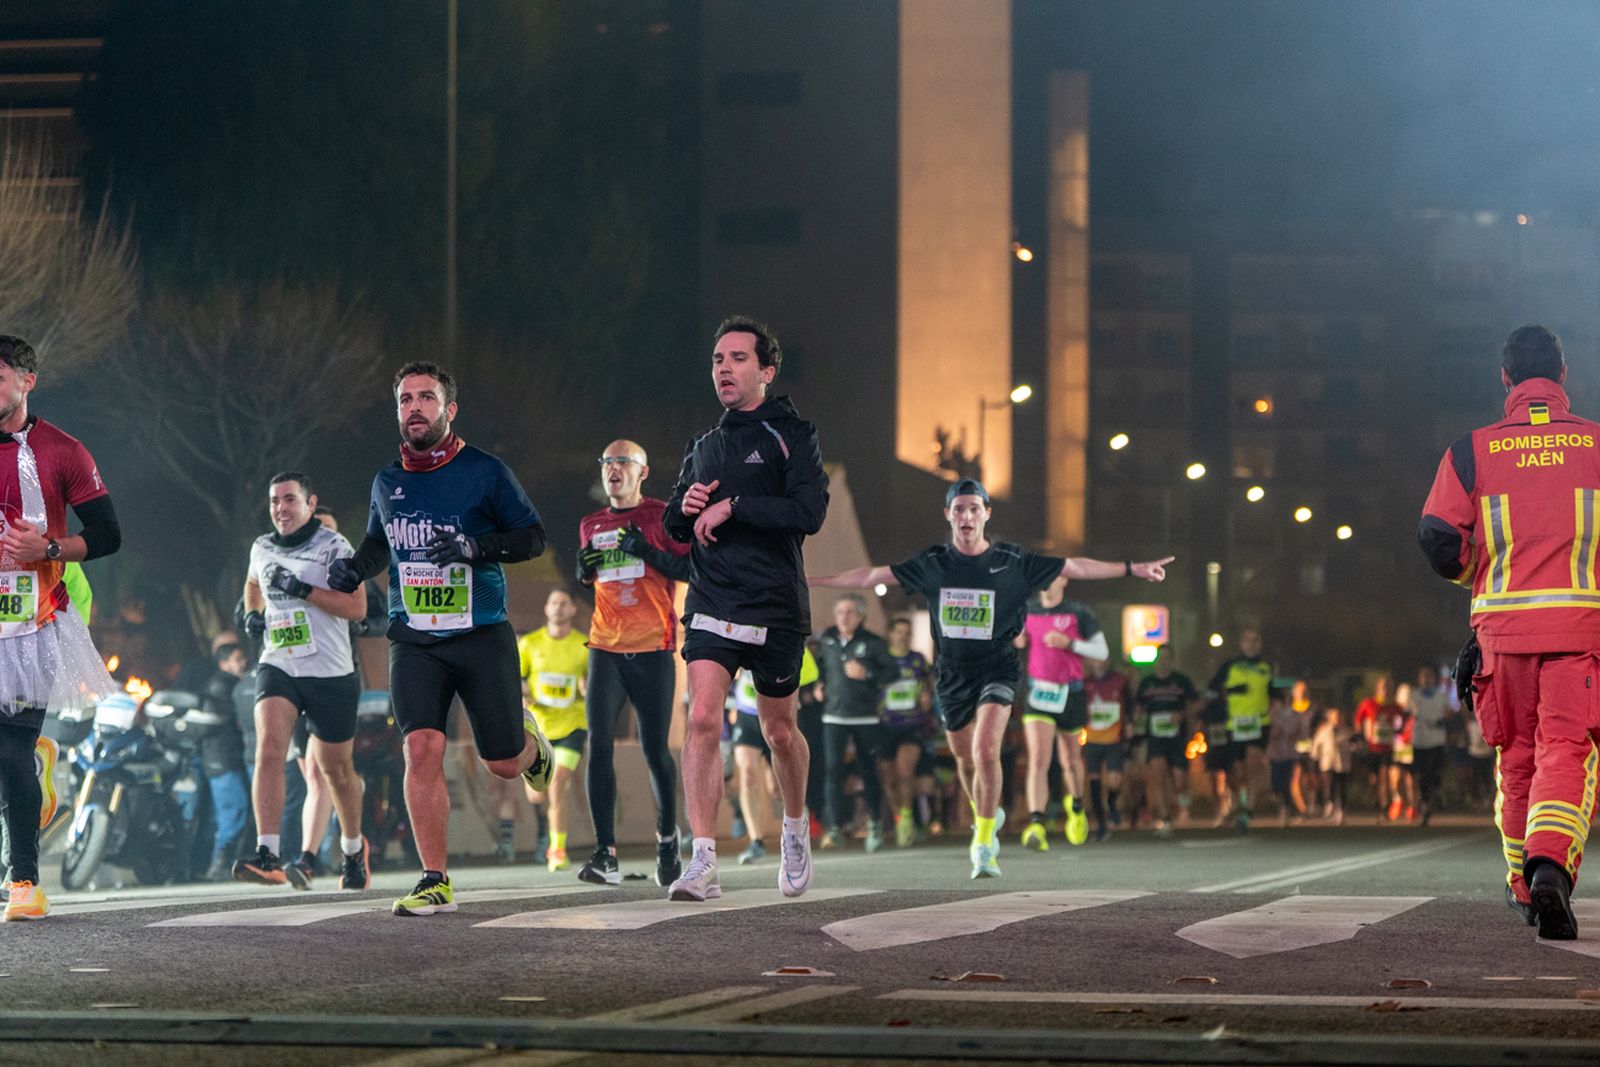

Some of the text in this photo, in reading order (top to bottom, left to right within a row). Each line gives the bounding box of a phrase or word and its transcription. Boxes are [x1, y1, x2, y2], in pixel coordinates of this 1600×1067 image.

[1489, 434, 1594, 454] BOMBEROS
[1516, 450, 1564, 468] JAÉN
[413, 586, 455, 607] 7182
[948, 606, 986, 622] 12827
